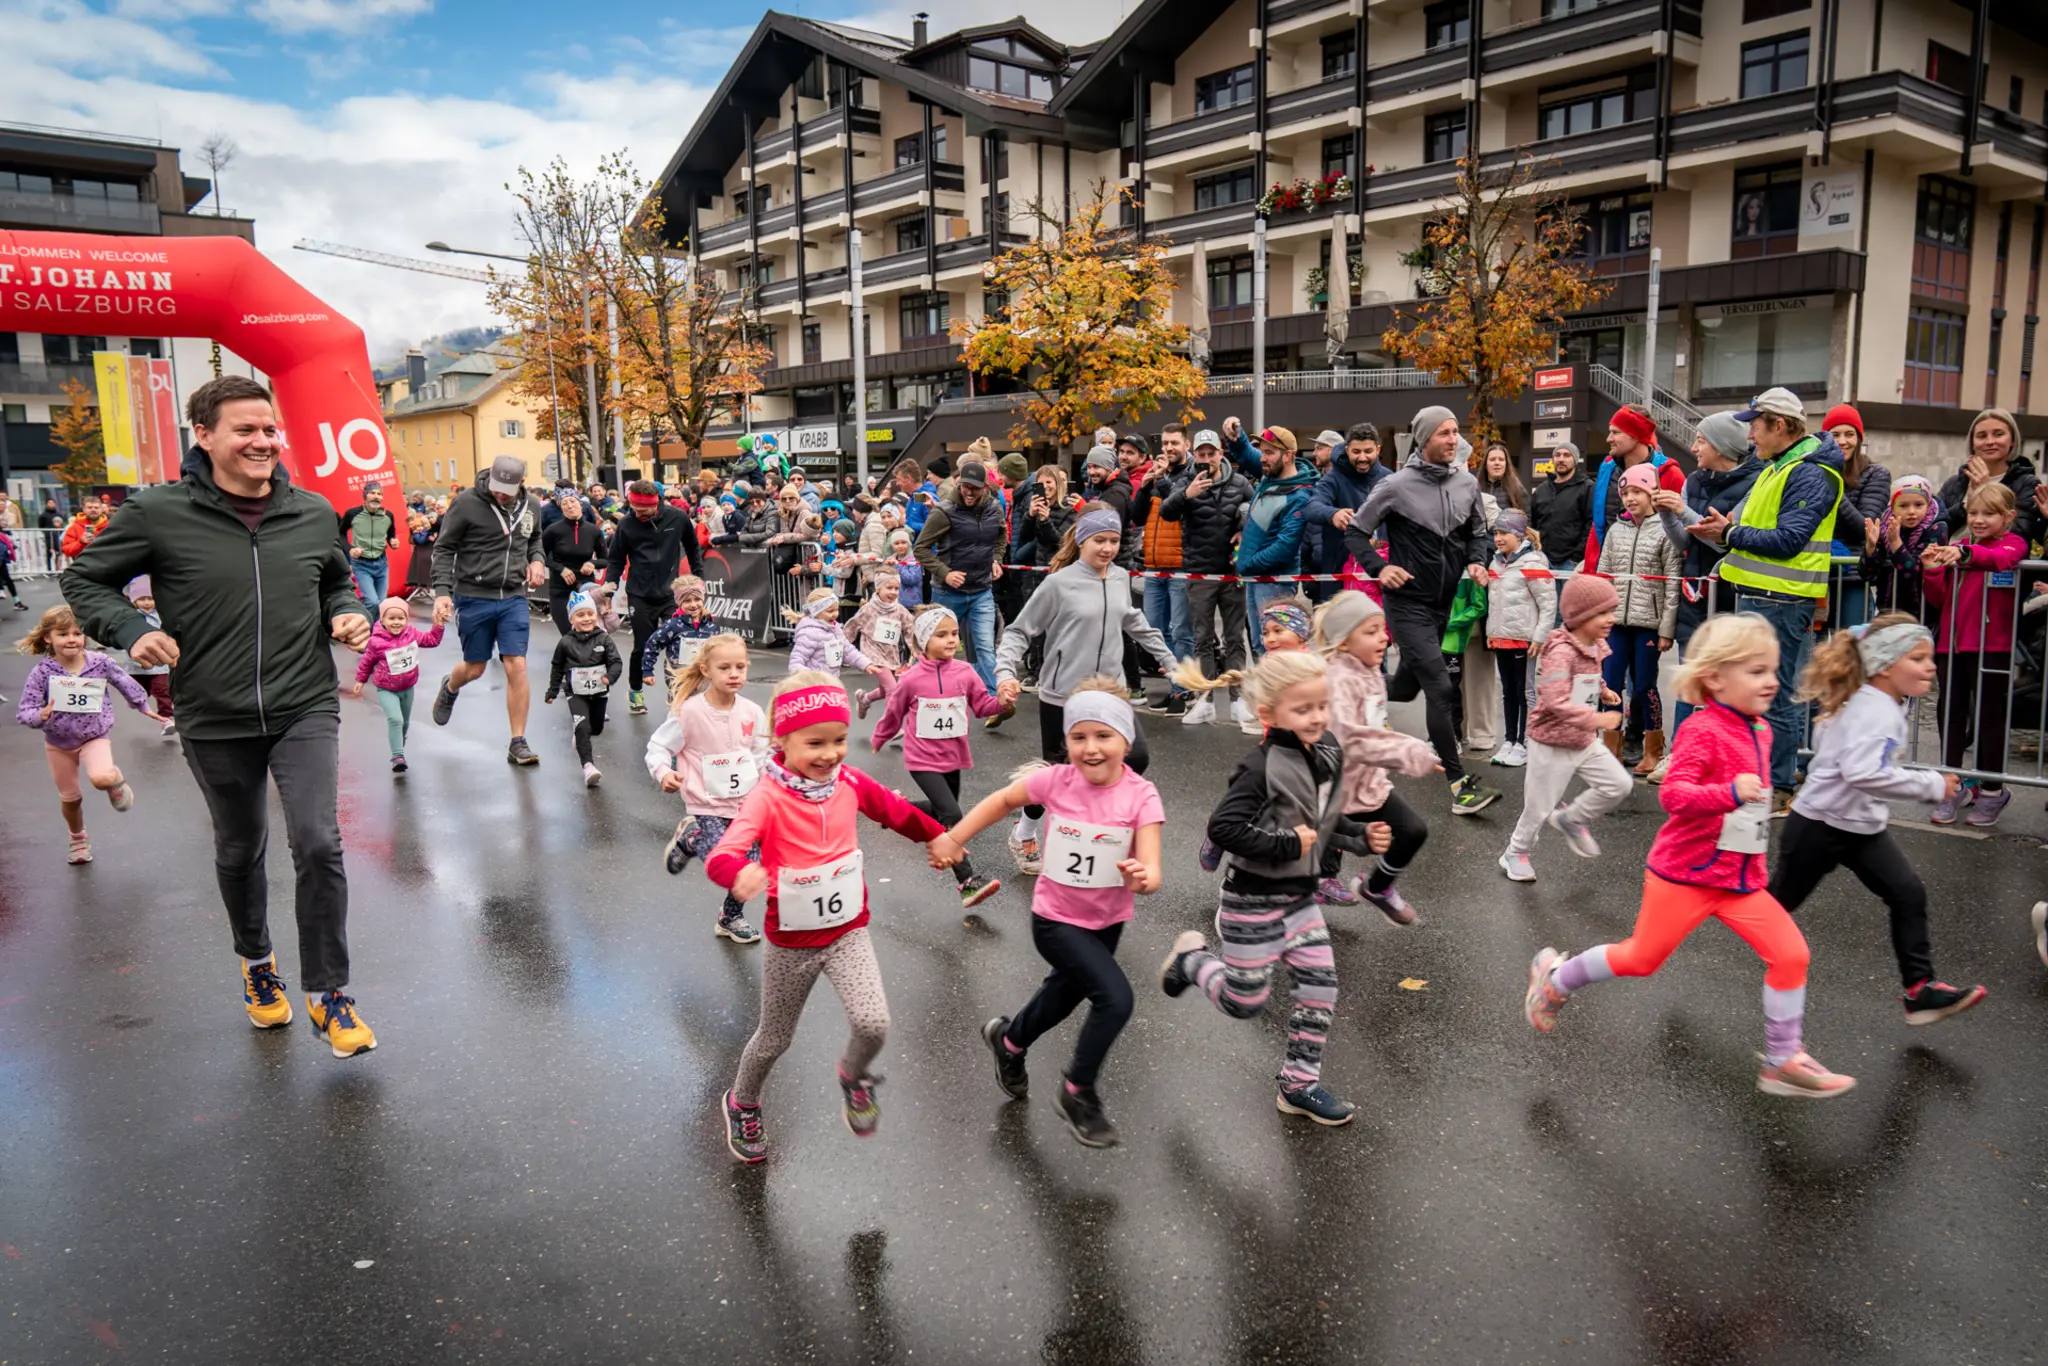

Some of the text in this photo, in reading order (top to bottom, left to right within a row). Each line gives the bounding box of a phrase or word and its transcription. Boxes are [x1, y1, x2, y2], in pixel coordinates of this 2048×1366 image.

[88, 249, 168, 263] WELCOME
[14, 292, 176, 315] SALZBURG
[1720, 298, 1807, 315] VERSICHERUNGEN
[240, 313, 329, 325] JOsalzburg.com
[314, 418, 387, 478] JO
[799, 431, 829, 449] KRABB
[799, 457, 837, 465] OPTIK KRABB
[705, 577, 726, 596] ort
[704, 596, 753, 621] NDNER
[884, 630, 896, 640] 33
[400, 656, 413, 668] 37
[584, 679, 597, 690] 45
[67, 693, 88, 706] 38
[933, 717, 954, 731] 44
[730, 773, 740, 789] 5
[1066, 852, 1095, 876] 21
[812, 891, 843, 917] 16
